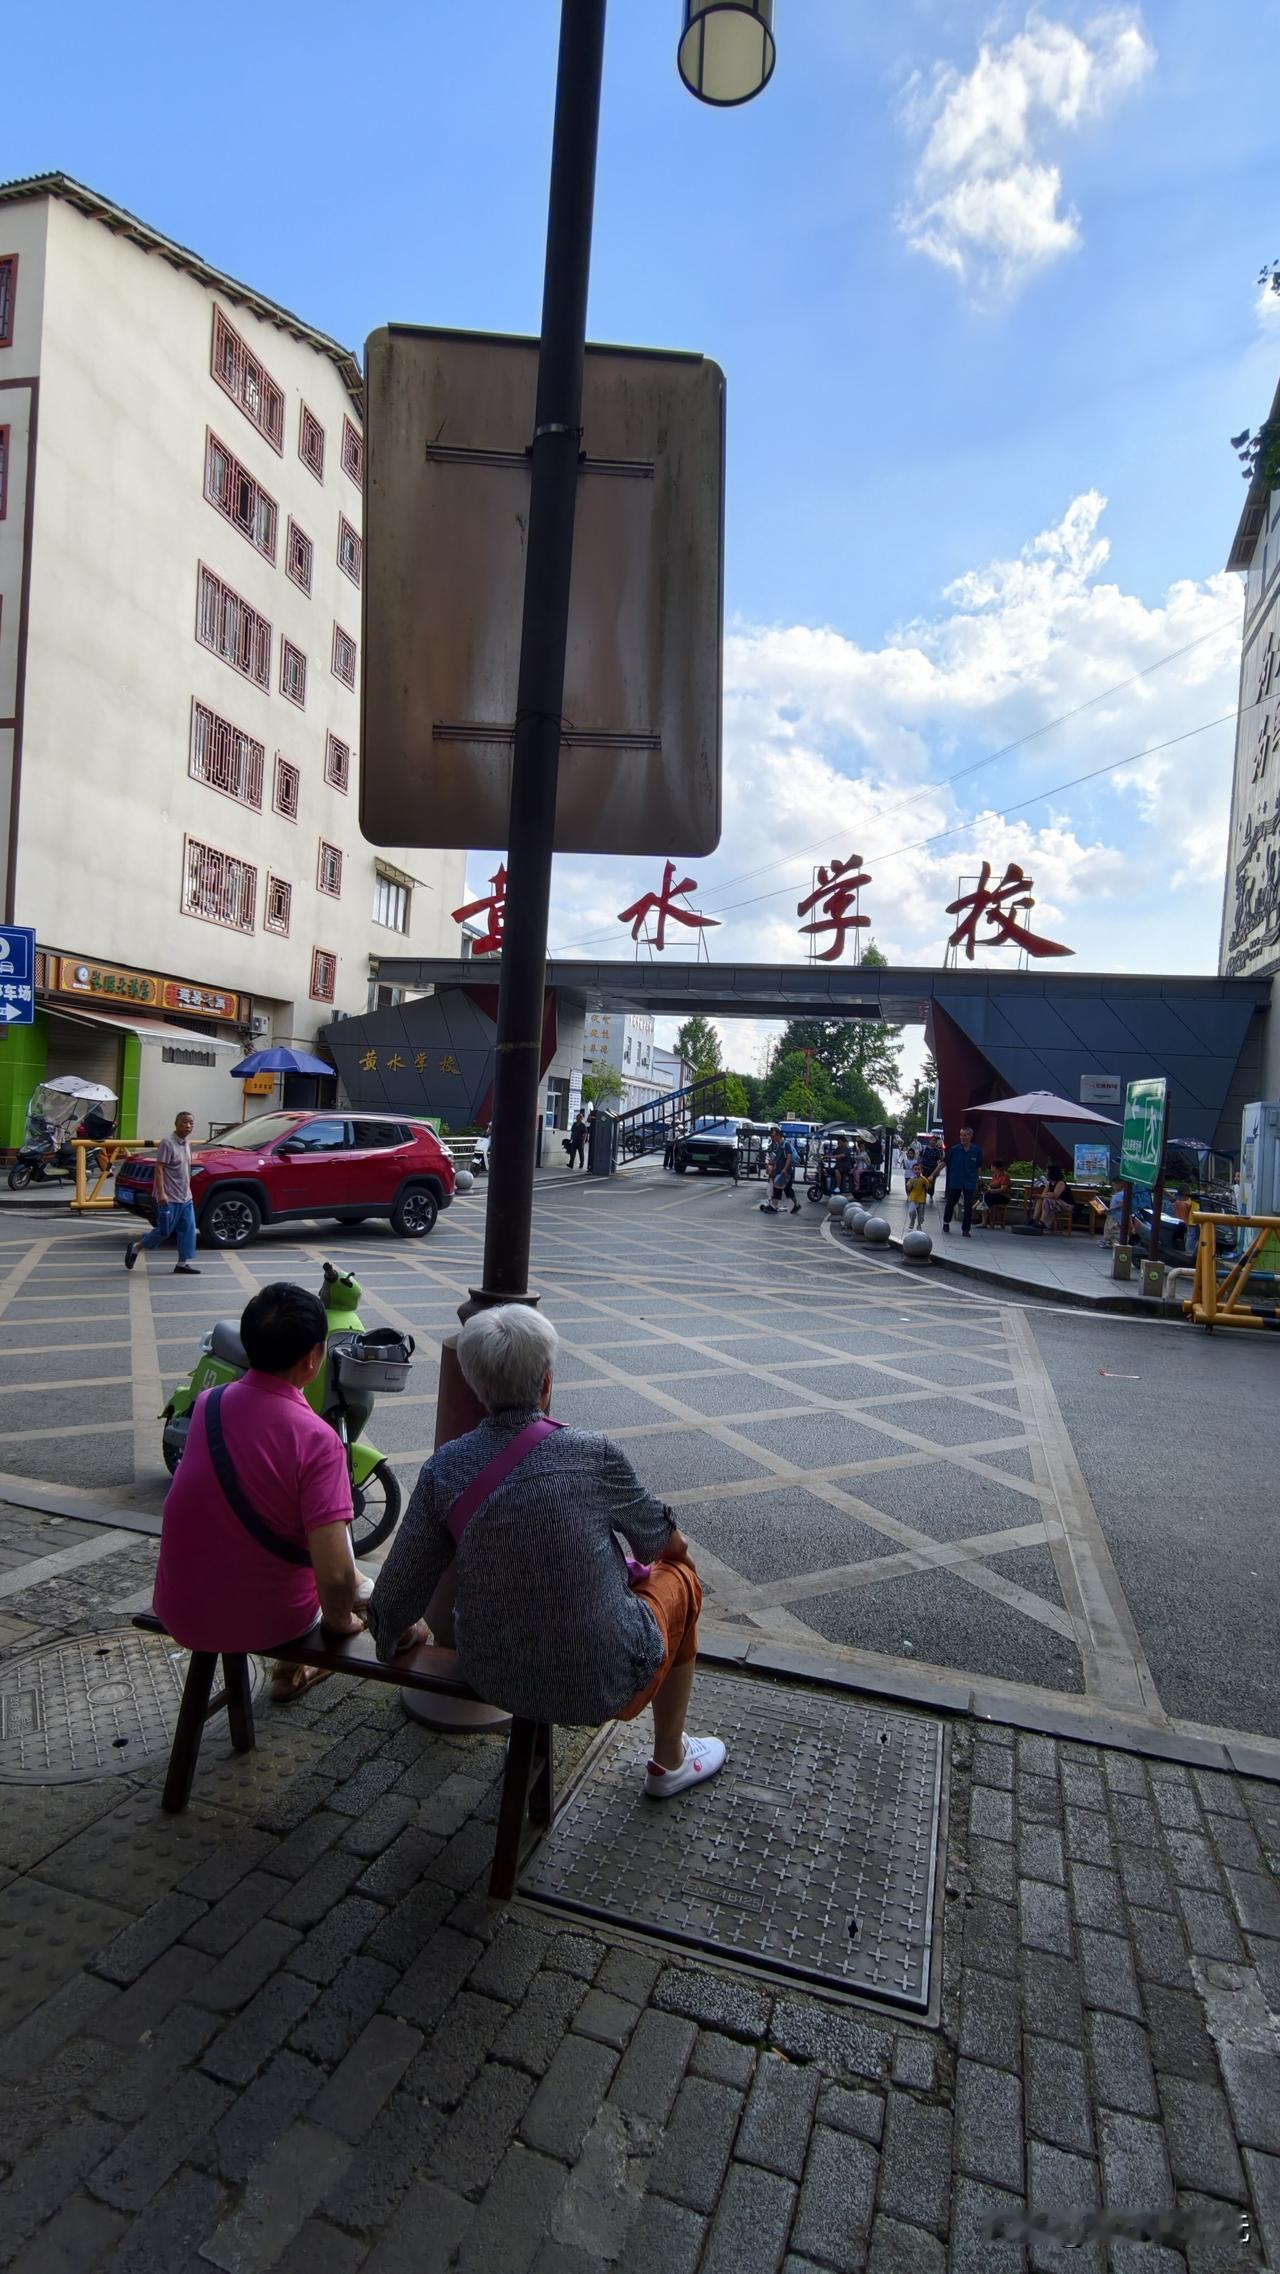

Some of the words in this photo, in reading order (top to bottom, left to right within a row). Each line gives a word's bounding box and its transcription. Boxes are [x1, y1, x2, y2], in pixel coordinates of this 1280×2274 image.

[0, 984, 32, 1002] 车场
[358, 1049, 462, 1075] 黄水学校
